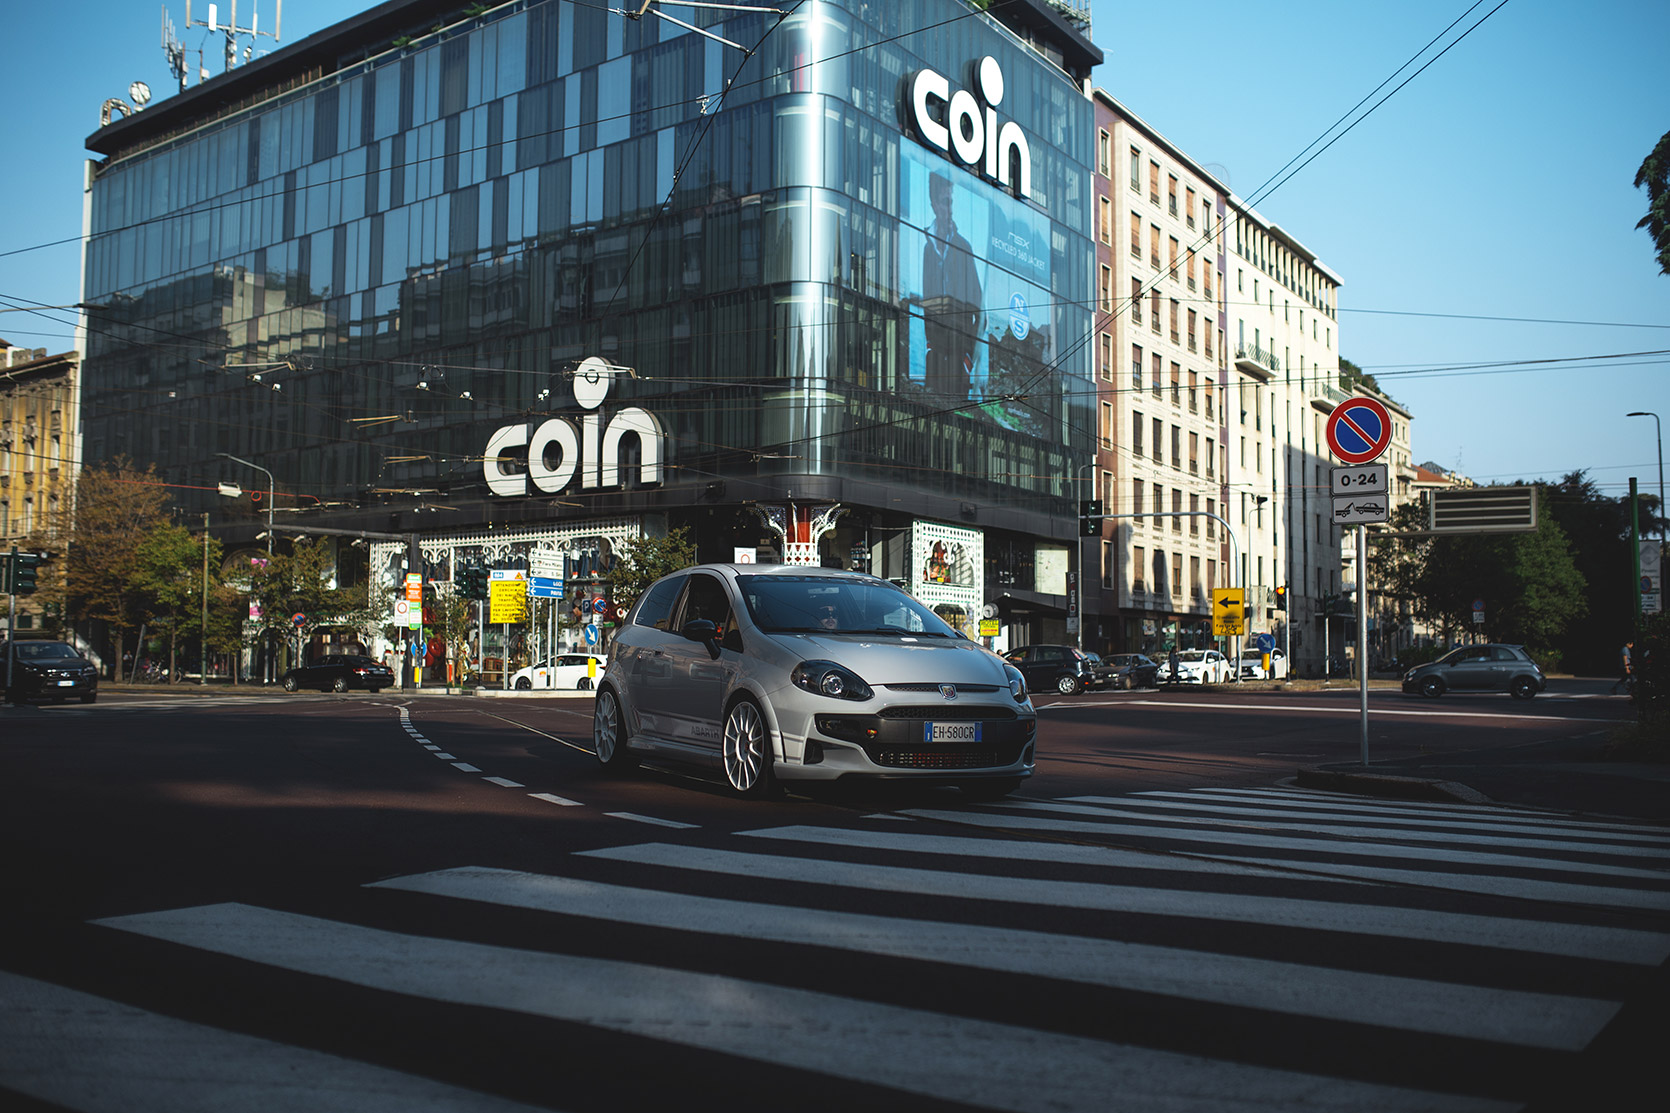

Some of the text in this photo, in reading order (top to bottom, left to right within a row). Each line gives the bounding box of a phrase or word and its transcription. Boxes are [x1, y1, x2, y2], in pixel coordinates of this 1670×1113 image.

[912, 55, 1032, 199] coin
[483, 356, 658, 497] coin
[1341, 472, 1377, 487] 0-24
[690, 725, 720, 739] ABARTH
